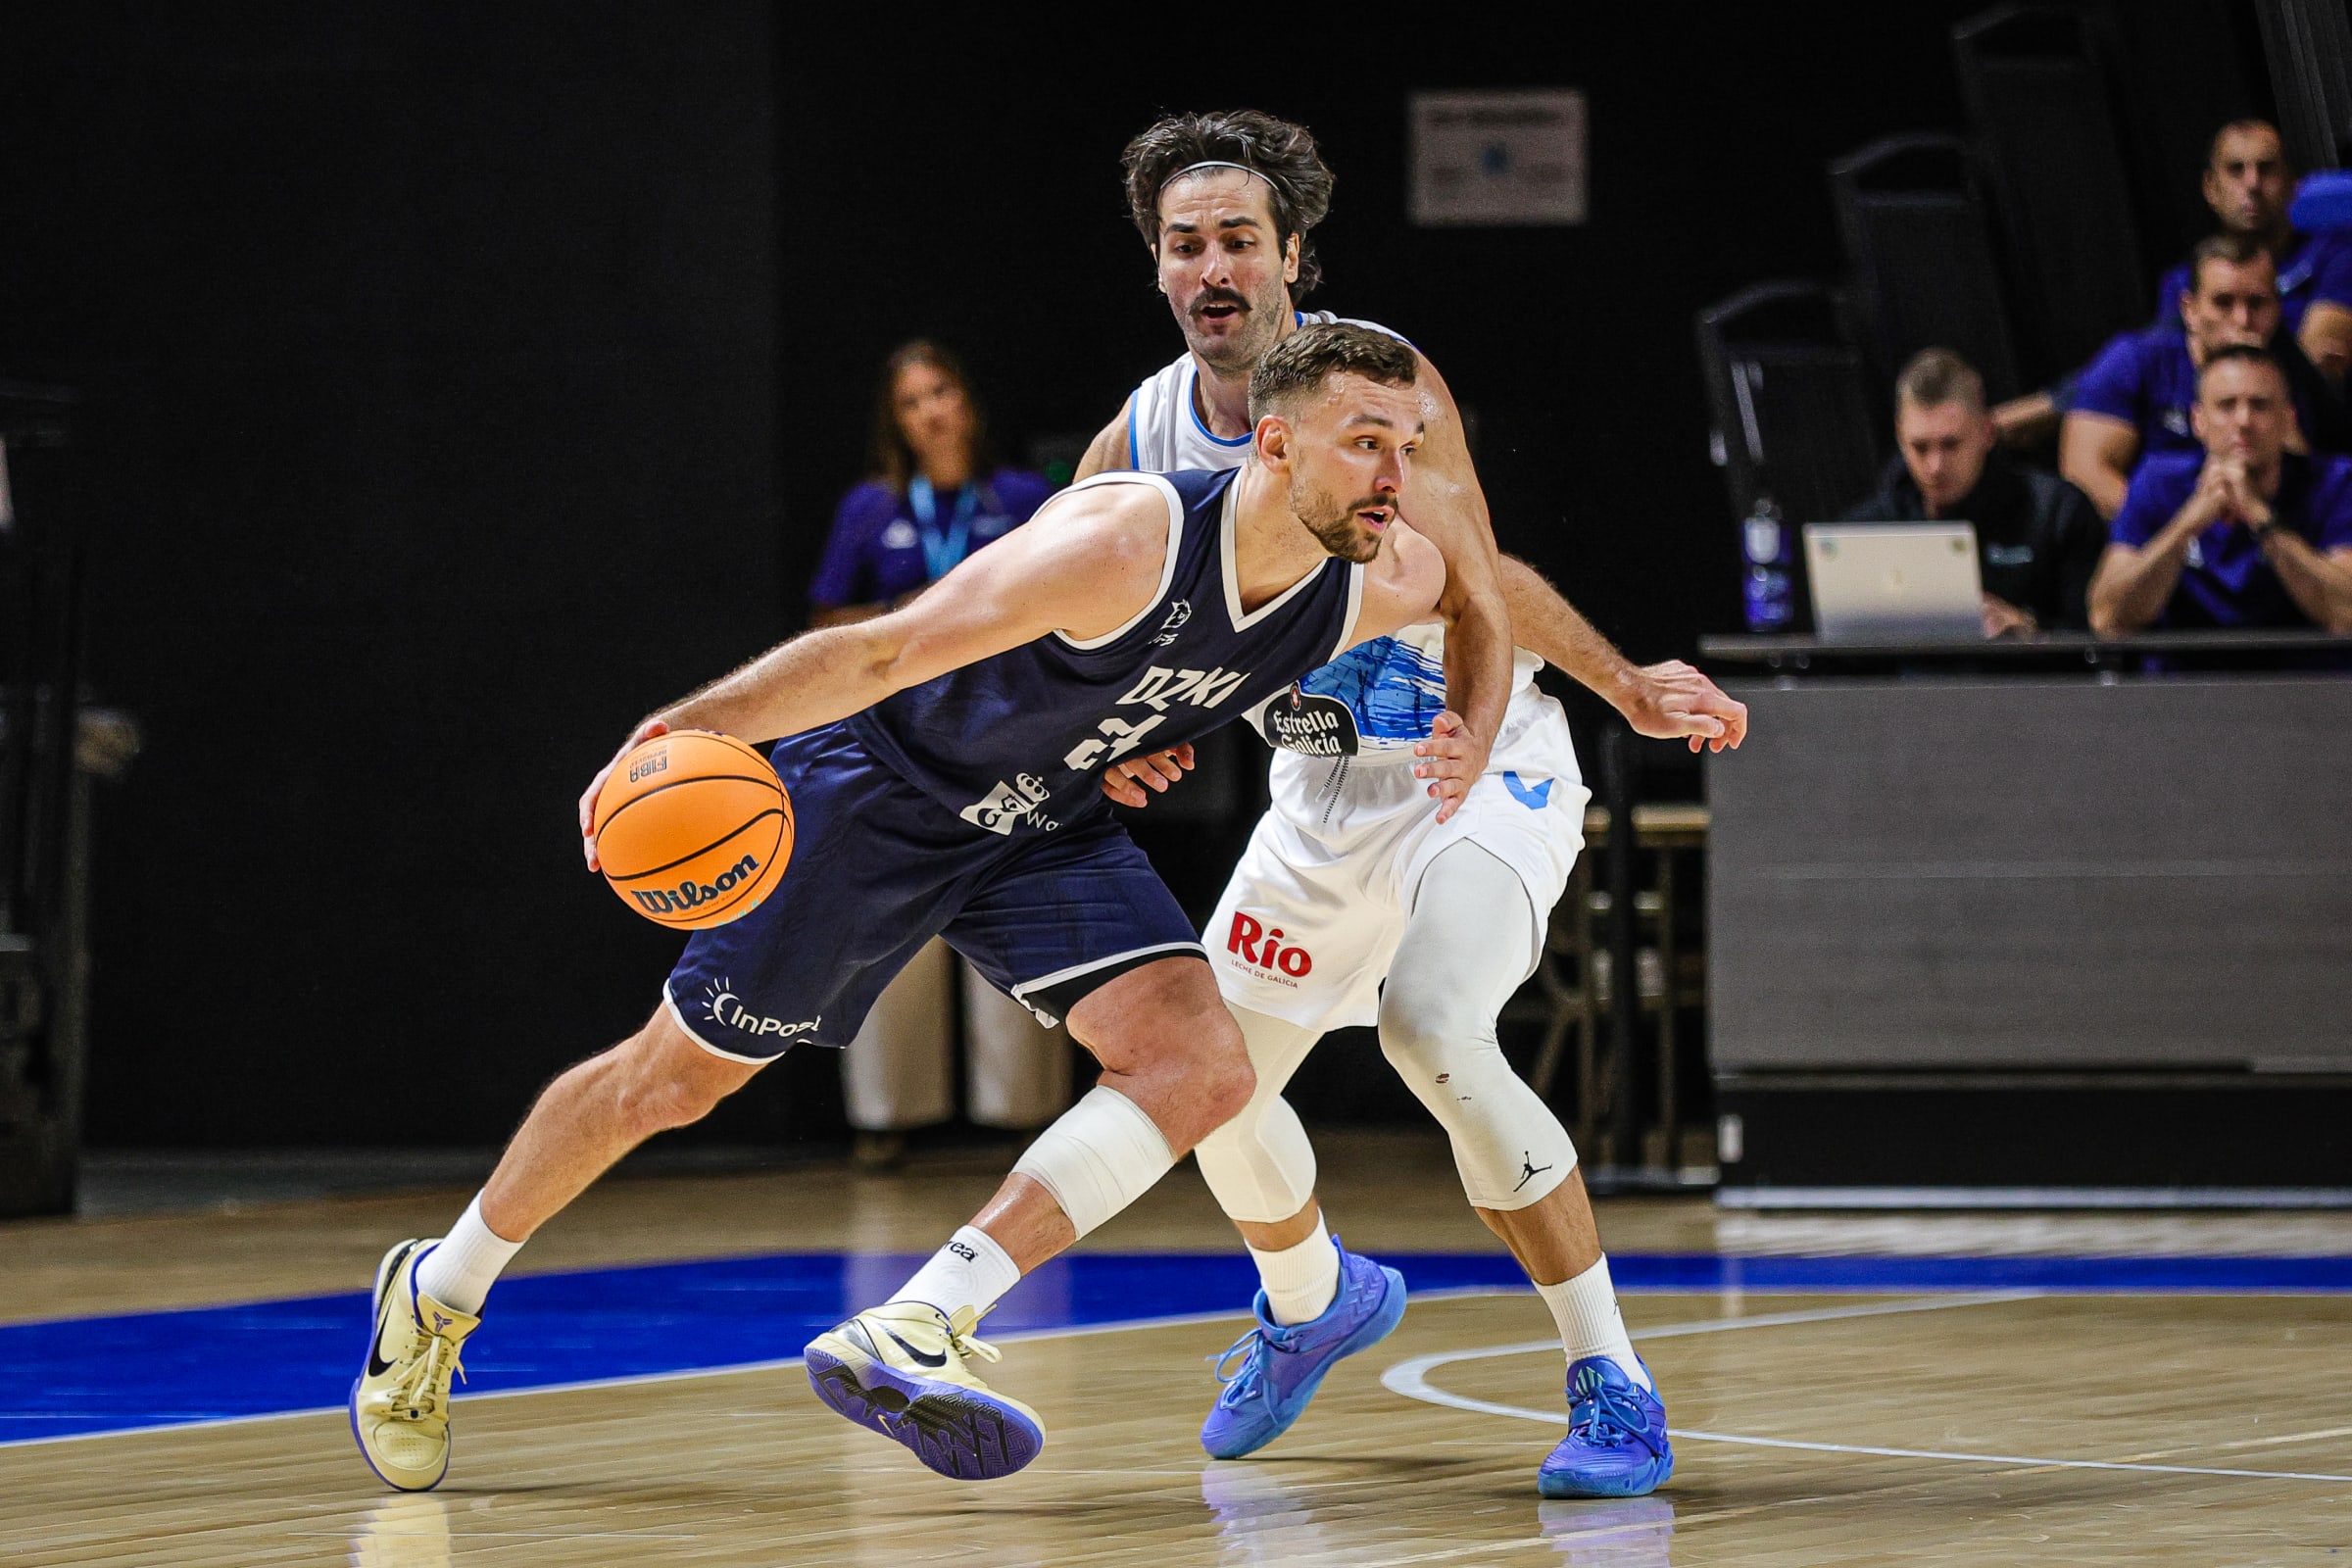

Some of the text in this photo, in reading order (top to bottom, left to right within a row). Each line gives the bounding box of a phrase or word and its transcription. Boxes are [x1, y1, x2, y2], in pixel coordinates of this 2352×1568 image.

[1273, 710, 1340, 734] Estrella
[630, 756, 667, 783] FIBA
[630, 854, 760, 913] Wilson
[1231, 958, 1298, 989] LECHE DE GALICIA
